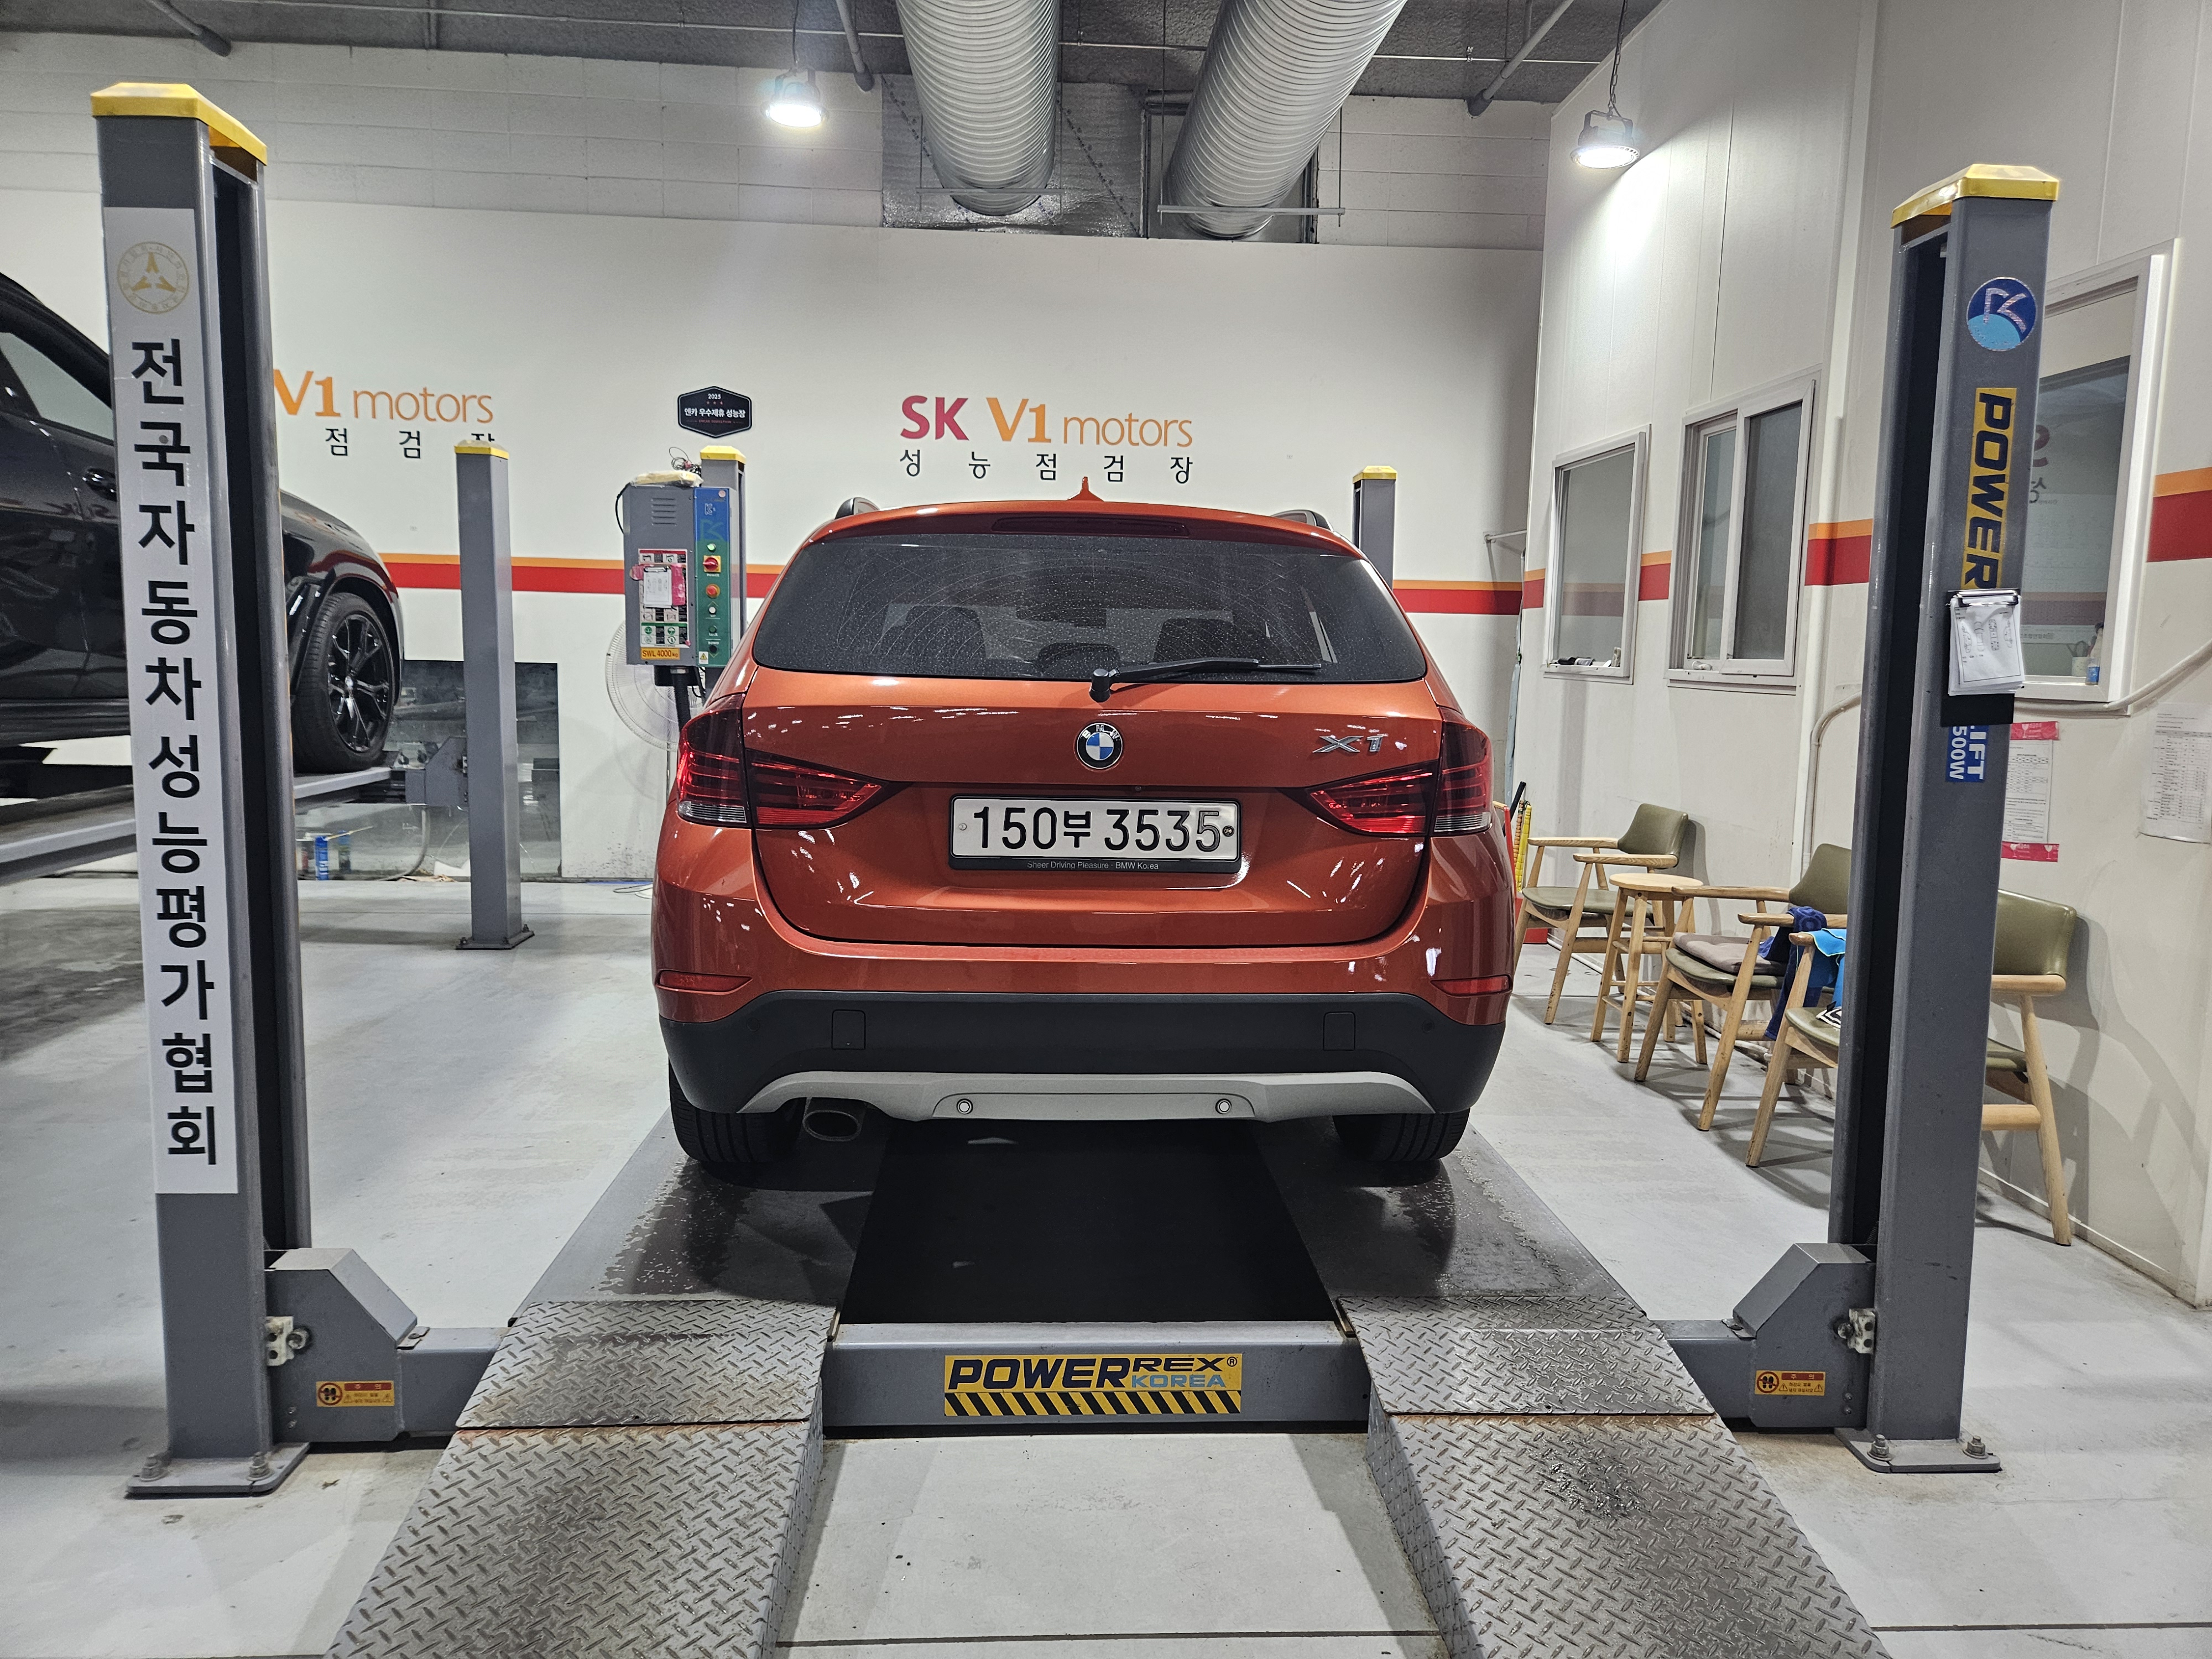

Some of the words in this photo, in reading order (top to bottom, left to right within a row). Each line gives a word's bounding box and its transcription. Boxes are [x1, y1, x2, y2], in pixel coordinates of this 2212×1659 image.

[273, 369, 341, 418] V1
[353, 387, 493, 424] motors
[900, 395, 969, 441] SK
[986, 397, 1051, 443] V1
[1063, 413, 1192, 447] motors
[1964, 392, 2012, 589] POWER
[1082, 725, 1119, 740] BMW
[1312, 735, 1384, 753] X1
[1966, 726, 1986, 780] IFT
[973, 806, 1092, 849] 150부
[1104, 809, 1221, 852] 3535
[1051, 861, 1076, 870] Driving
[1131, 1374, 1226, 1388] KOREA
